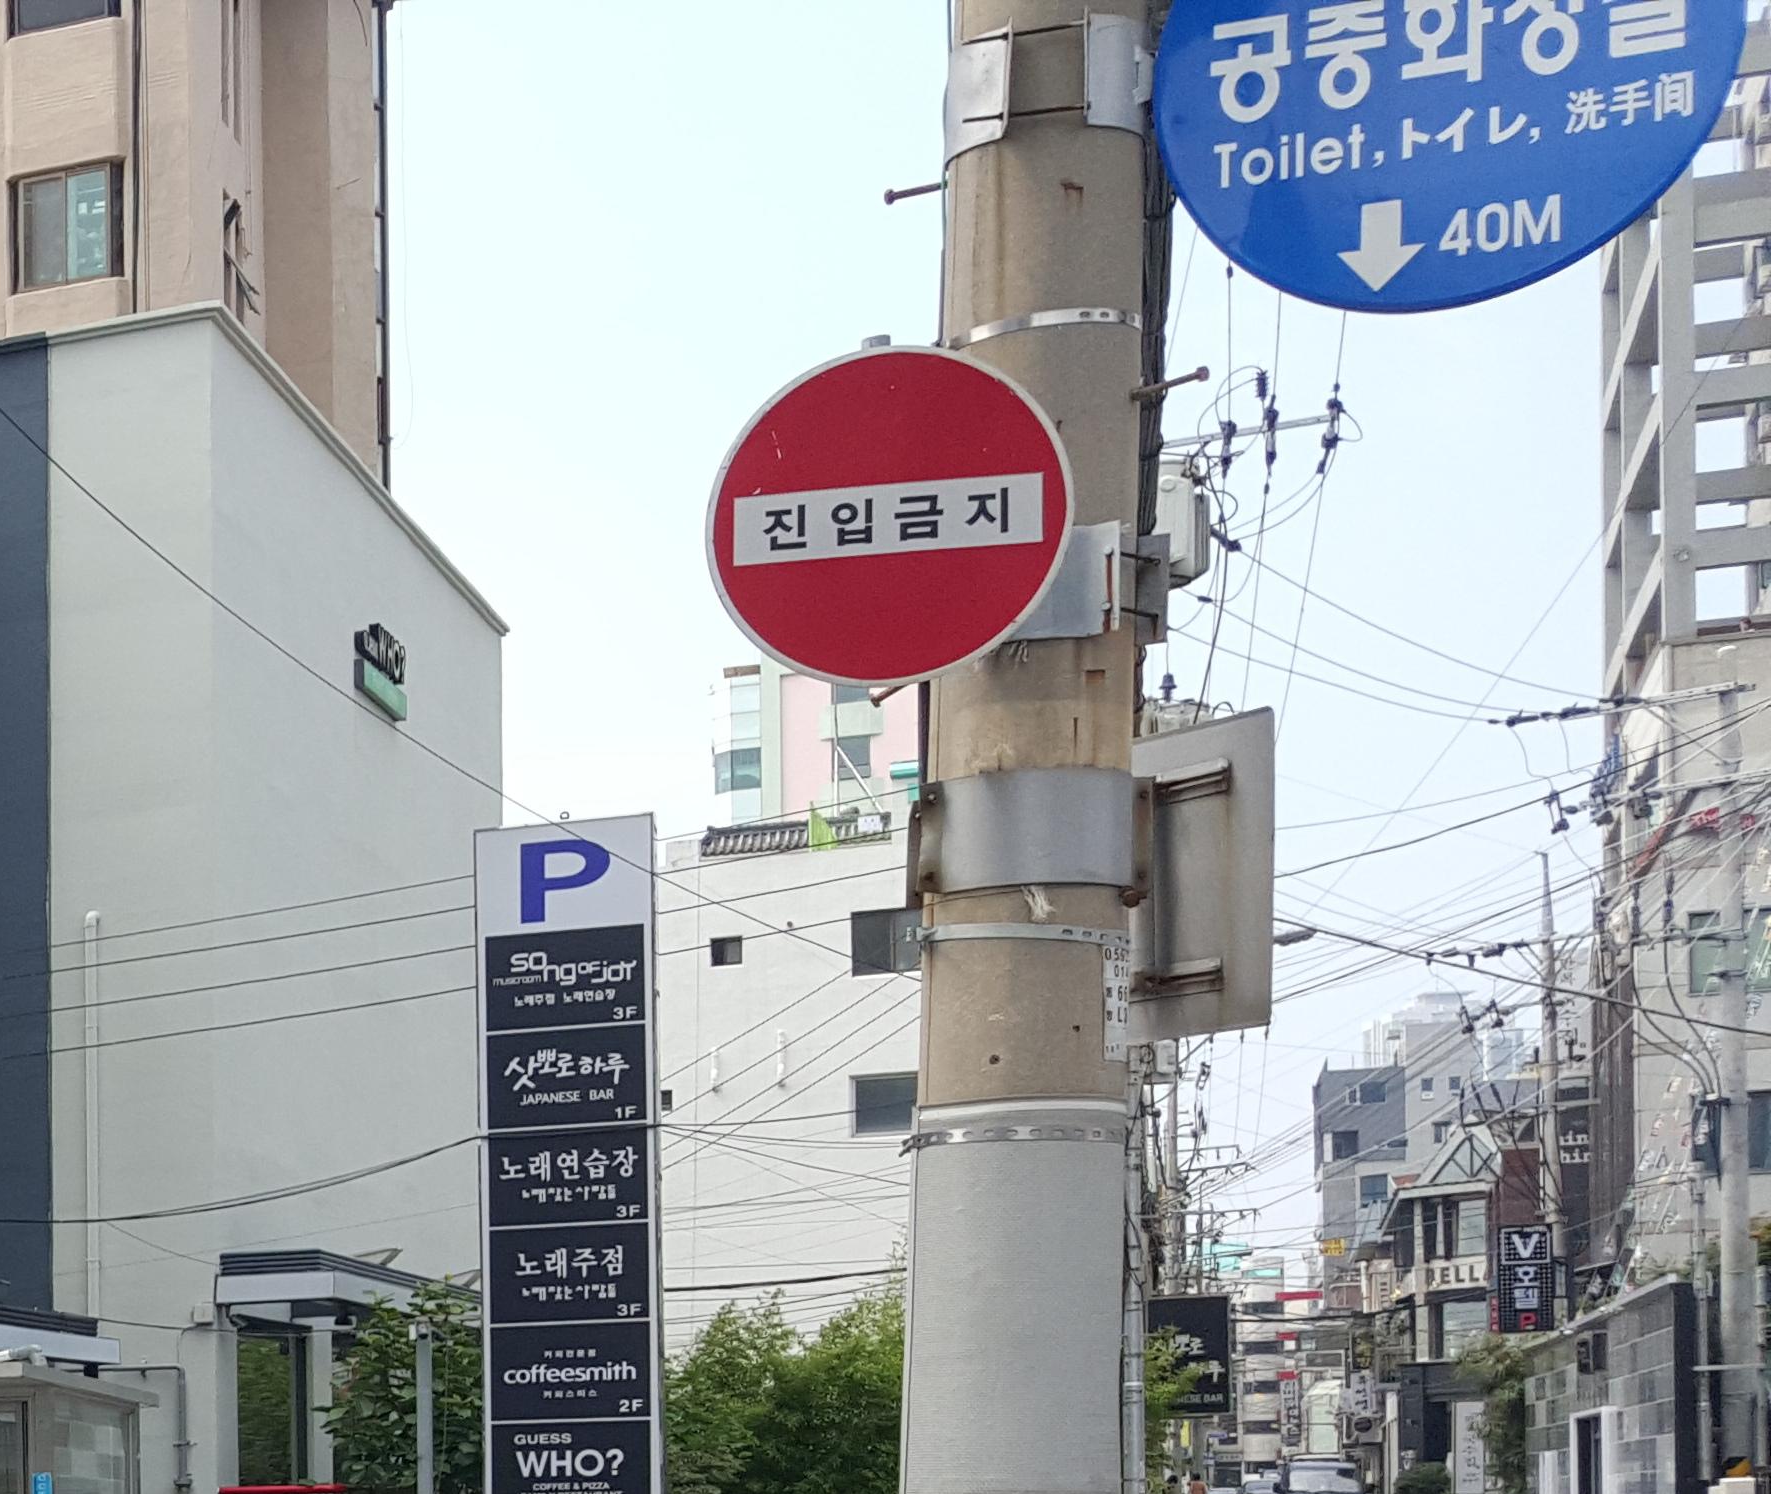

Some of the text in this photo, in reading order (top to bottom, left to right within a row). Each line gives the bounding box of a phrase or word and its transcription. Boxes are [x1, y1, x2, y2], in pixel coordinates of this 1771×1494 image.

[1564, 69, 1695, 135] 洗手间
[1438, 193, 1561, 257] 40M
[762, 486, 1010, 552] 진입금지
[521, 839, 610, 924] P
[613, 1006, 638, 1020] 3F
[520, 1088, 614, 1106] JAPANESE BAR
[615, 1106, 637, 1119] 1F
[499, 1146, 638, 1182] 노래연습장
[616, 1205, 640, 1217] 3F
[515, 1245, 623, 1278] 노래주점
[617, 1304, 641, 1316] 3F
[503, 1361, 637, 1384] coffeesmith
[619, 1399, 643, 1413] 2F
[514, 1433, 572, 1446] GUESS
[516, 1449, 624, 1478] WHO?
[533, 1483, 571, 1491] COFFEE
[582, 1482, 610, 1490] PIZZA
